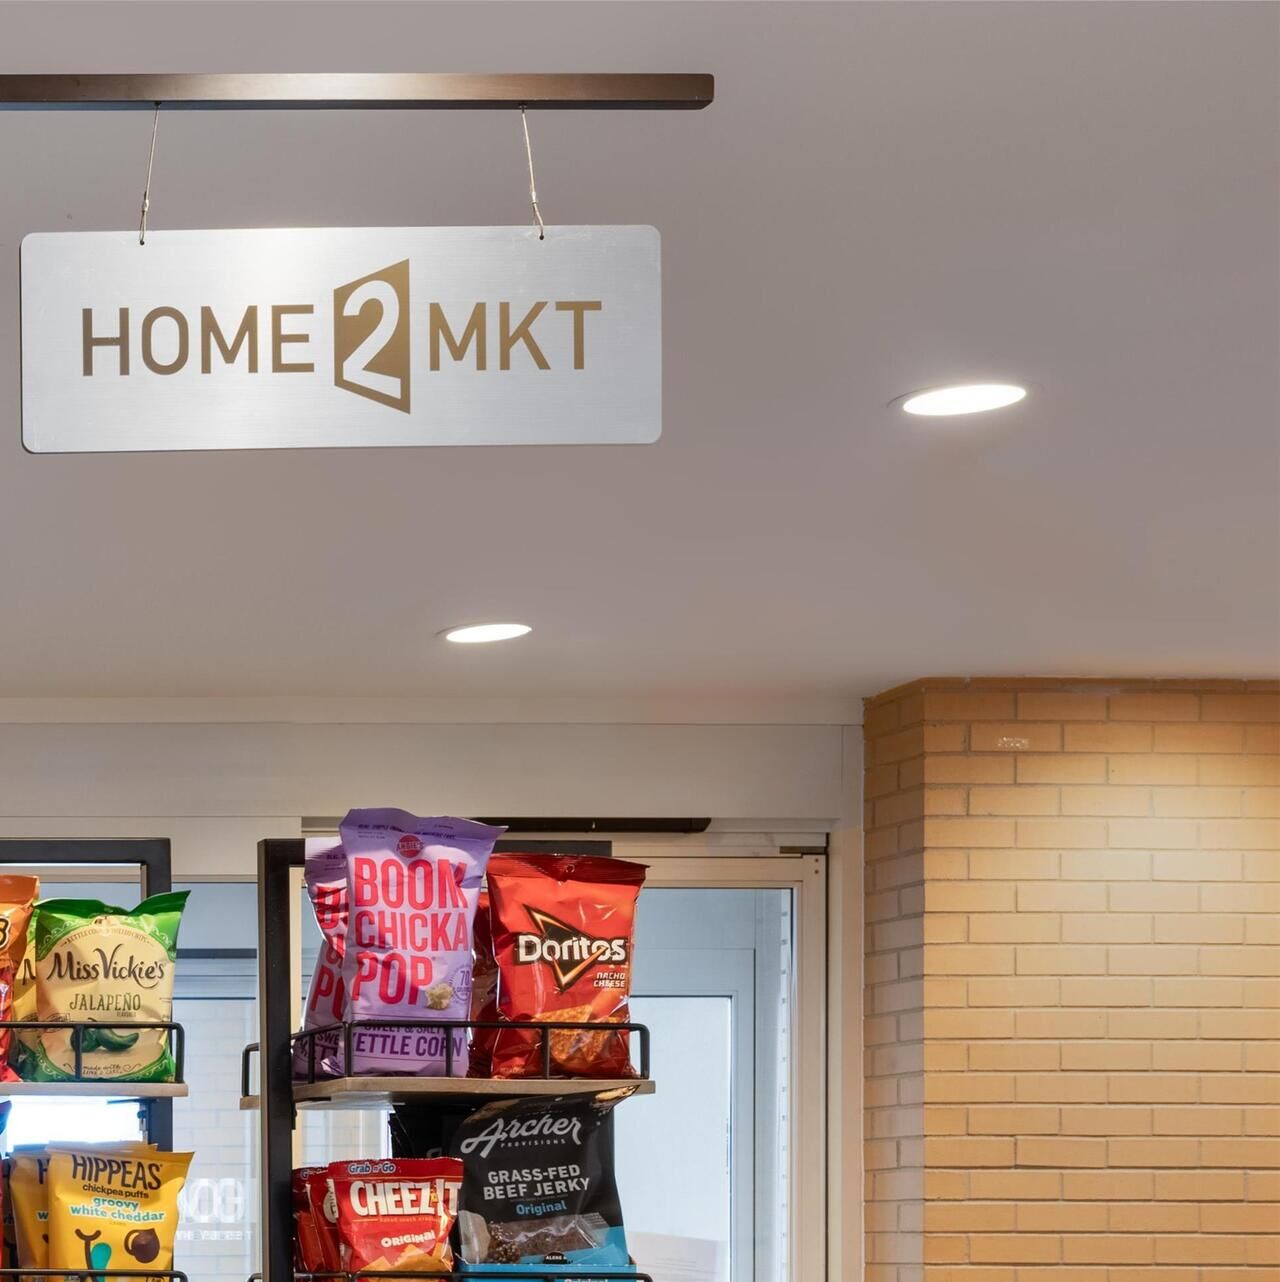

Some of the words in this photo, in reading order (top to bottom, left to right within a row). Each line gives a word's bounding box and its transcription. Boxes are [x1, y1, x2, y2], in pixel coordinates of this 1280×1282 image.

[83, 304, 315, 376] HOME
[342, 279, 401, 400] 2
[429, 301, 602, 371] MKT
[354, 857, 469, 908] BOOM
[355, 910, 469, 951] CHICKA
[517, 933, 626, 963] Doritos
[46, 950, 98, 982] Miss
[95, 943, 165, 988] Vickie's
[351, 952, 432, 1005] POP
[69, 993, 141, 1012] JALAPEÑO
[460, 1115, 582, 1158] Archer
[71, 1153, 161, 1191] HIPPEAS
[483, 1183, 527, 1200] BEEF
[531, 1176, 591, 1196] JERKY
[487, 1163, 581, 1185] GRASS-FED
[70, 1203, 108, 1218] white
[111, 1208, 165, 1223] cheddar
[93, 1197, 139, 1212] groovy
[515, 1199, 567, 1216] Original
